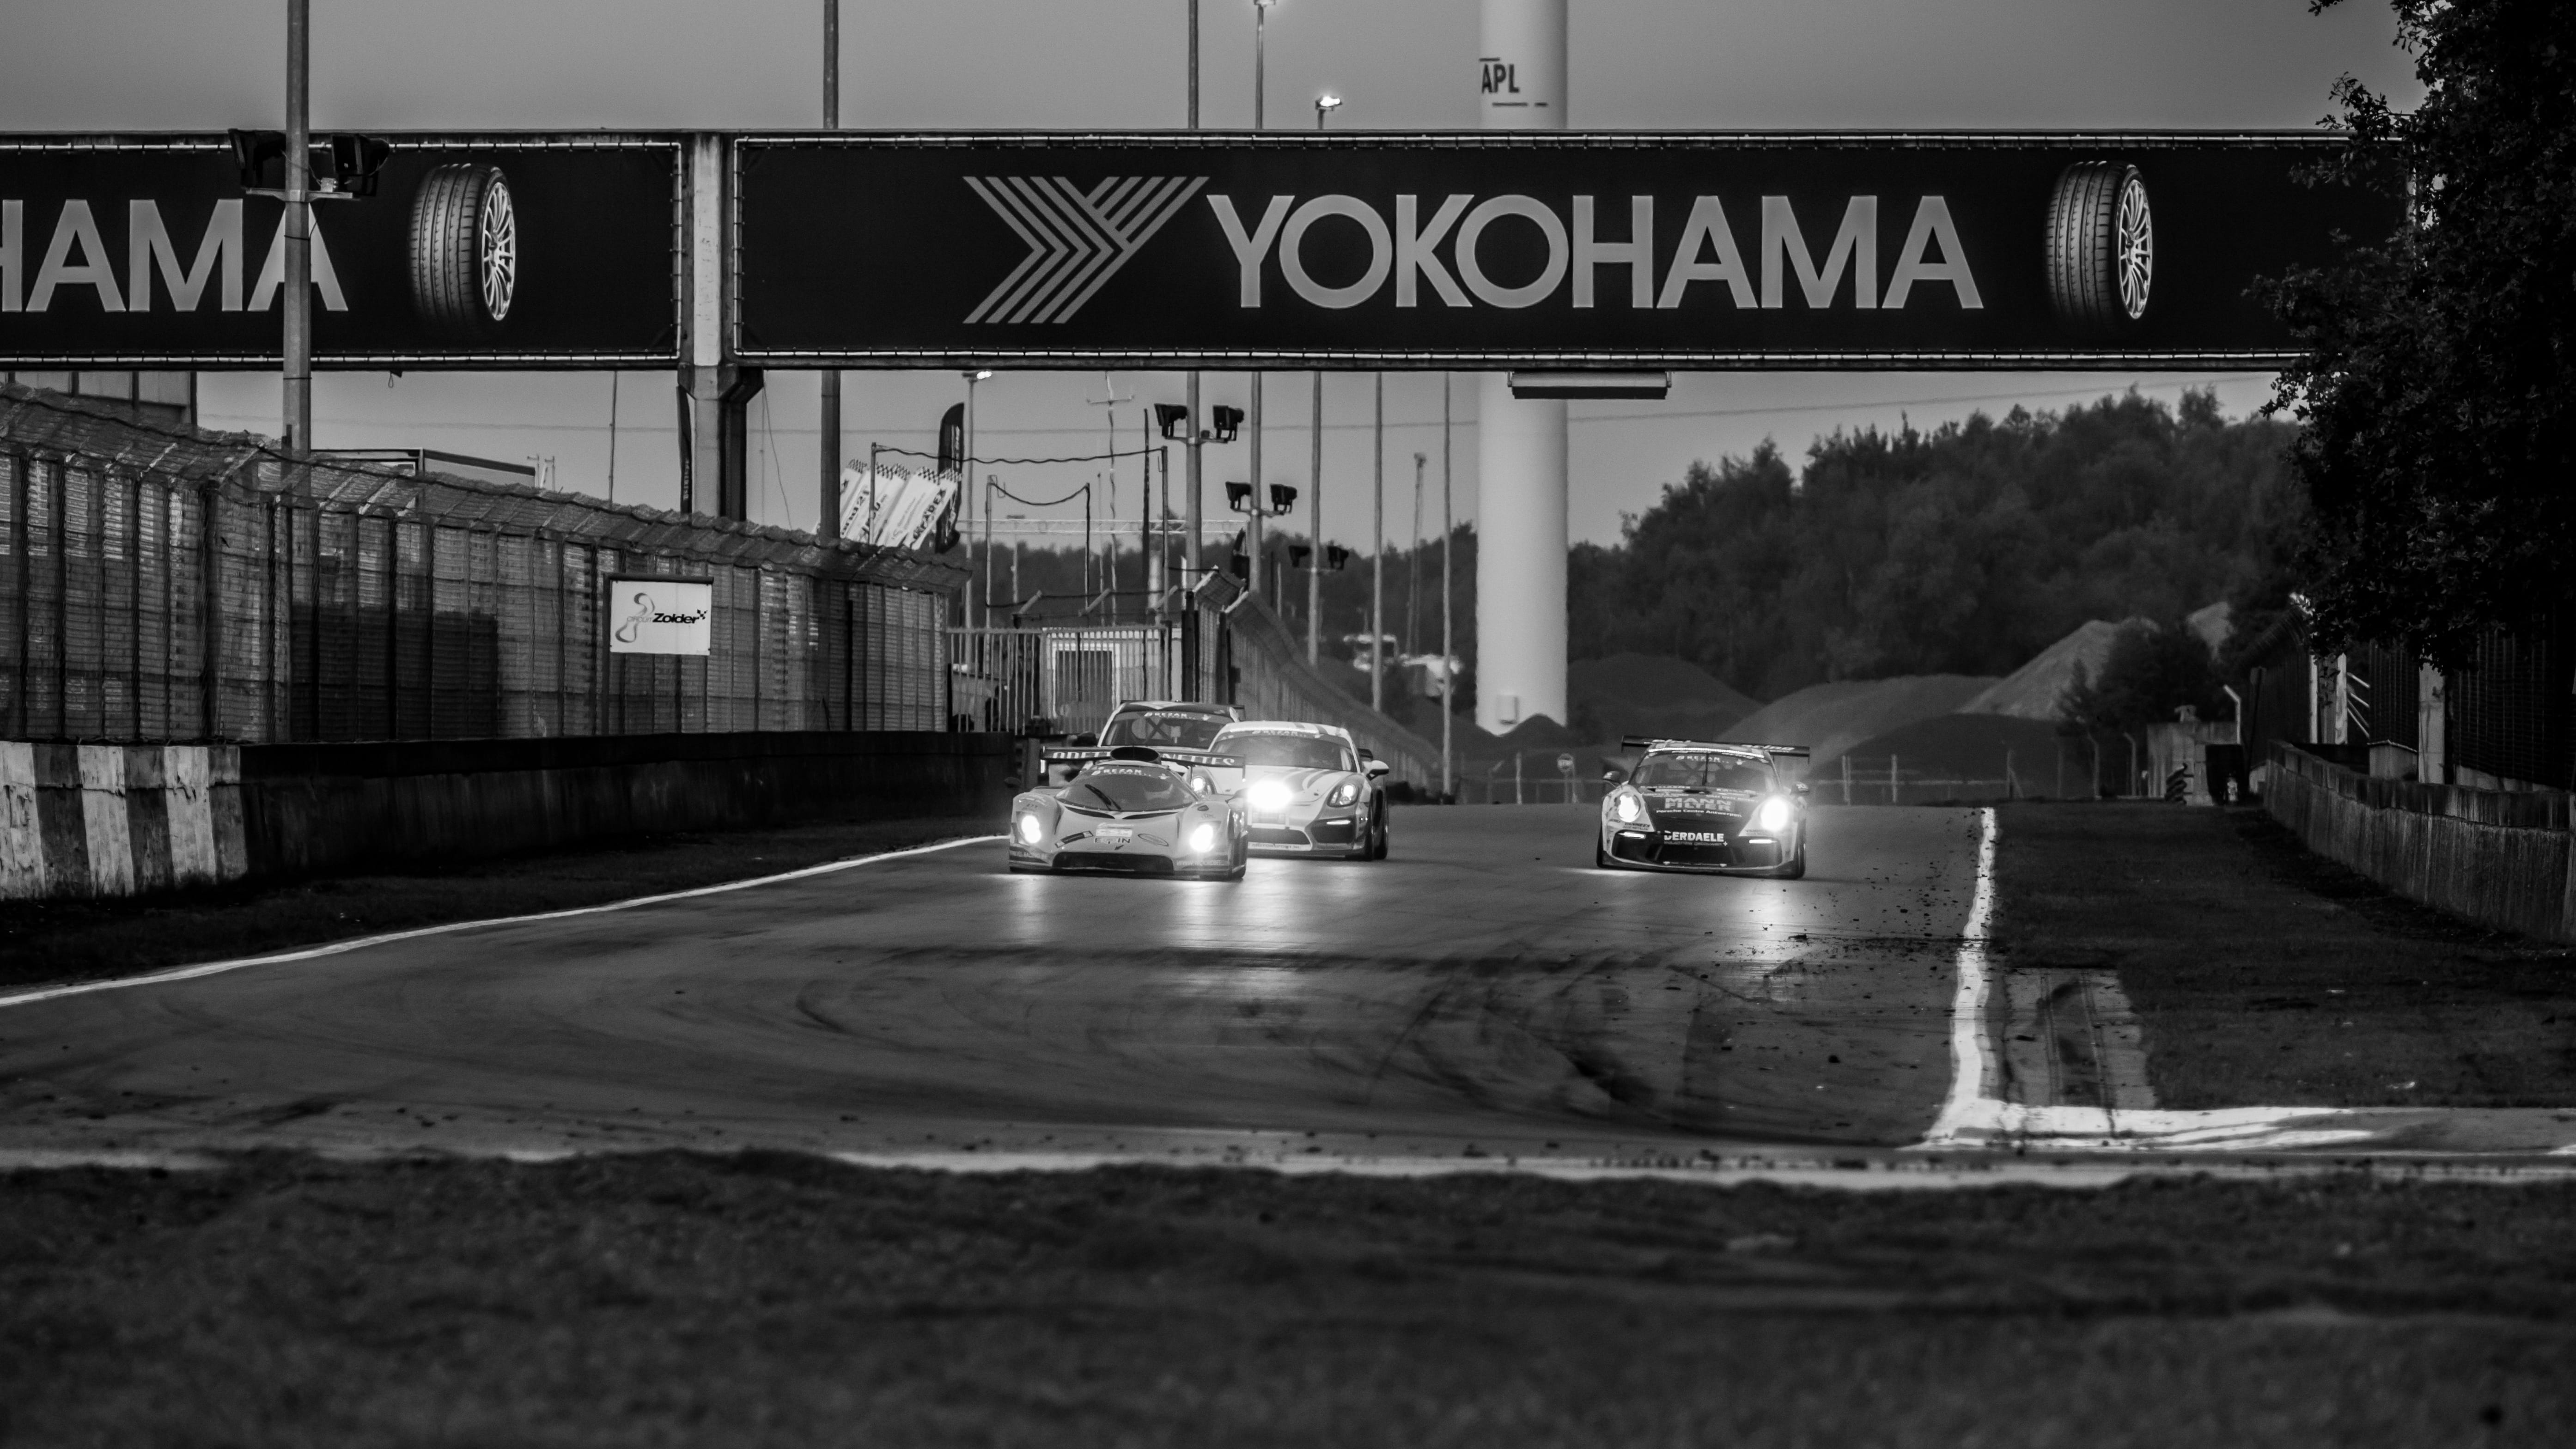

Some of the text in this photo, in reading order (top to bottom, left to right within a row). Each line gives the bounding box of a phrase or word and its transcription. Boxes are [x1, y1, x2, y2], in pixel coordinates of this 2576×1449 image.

[1481, 63, 1520, 94] APL
[1206, 194, 1984, 309] YOKOHAMA
[652, 613, 699, 624] Zolder
[1162, 753, 1235, 766] NETTES
[1665, 798, 1732, 806] MANN
[1665, 802, 1731, 811] FILTER
